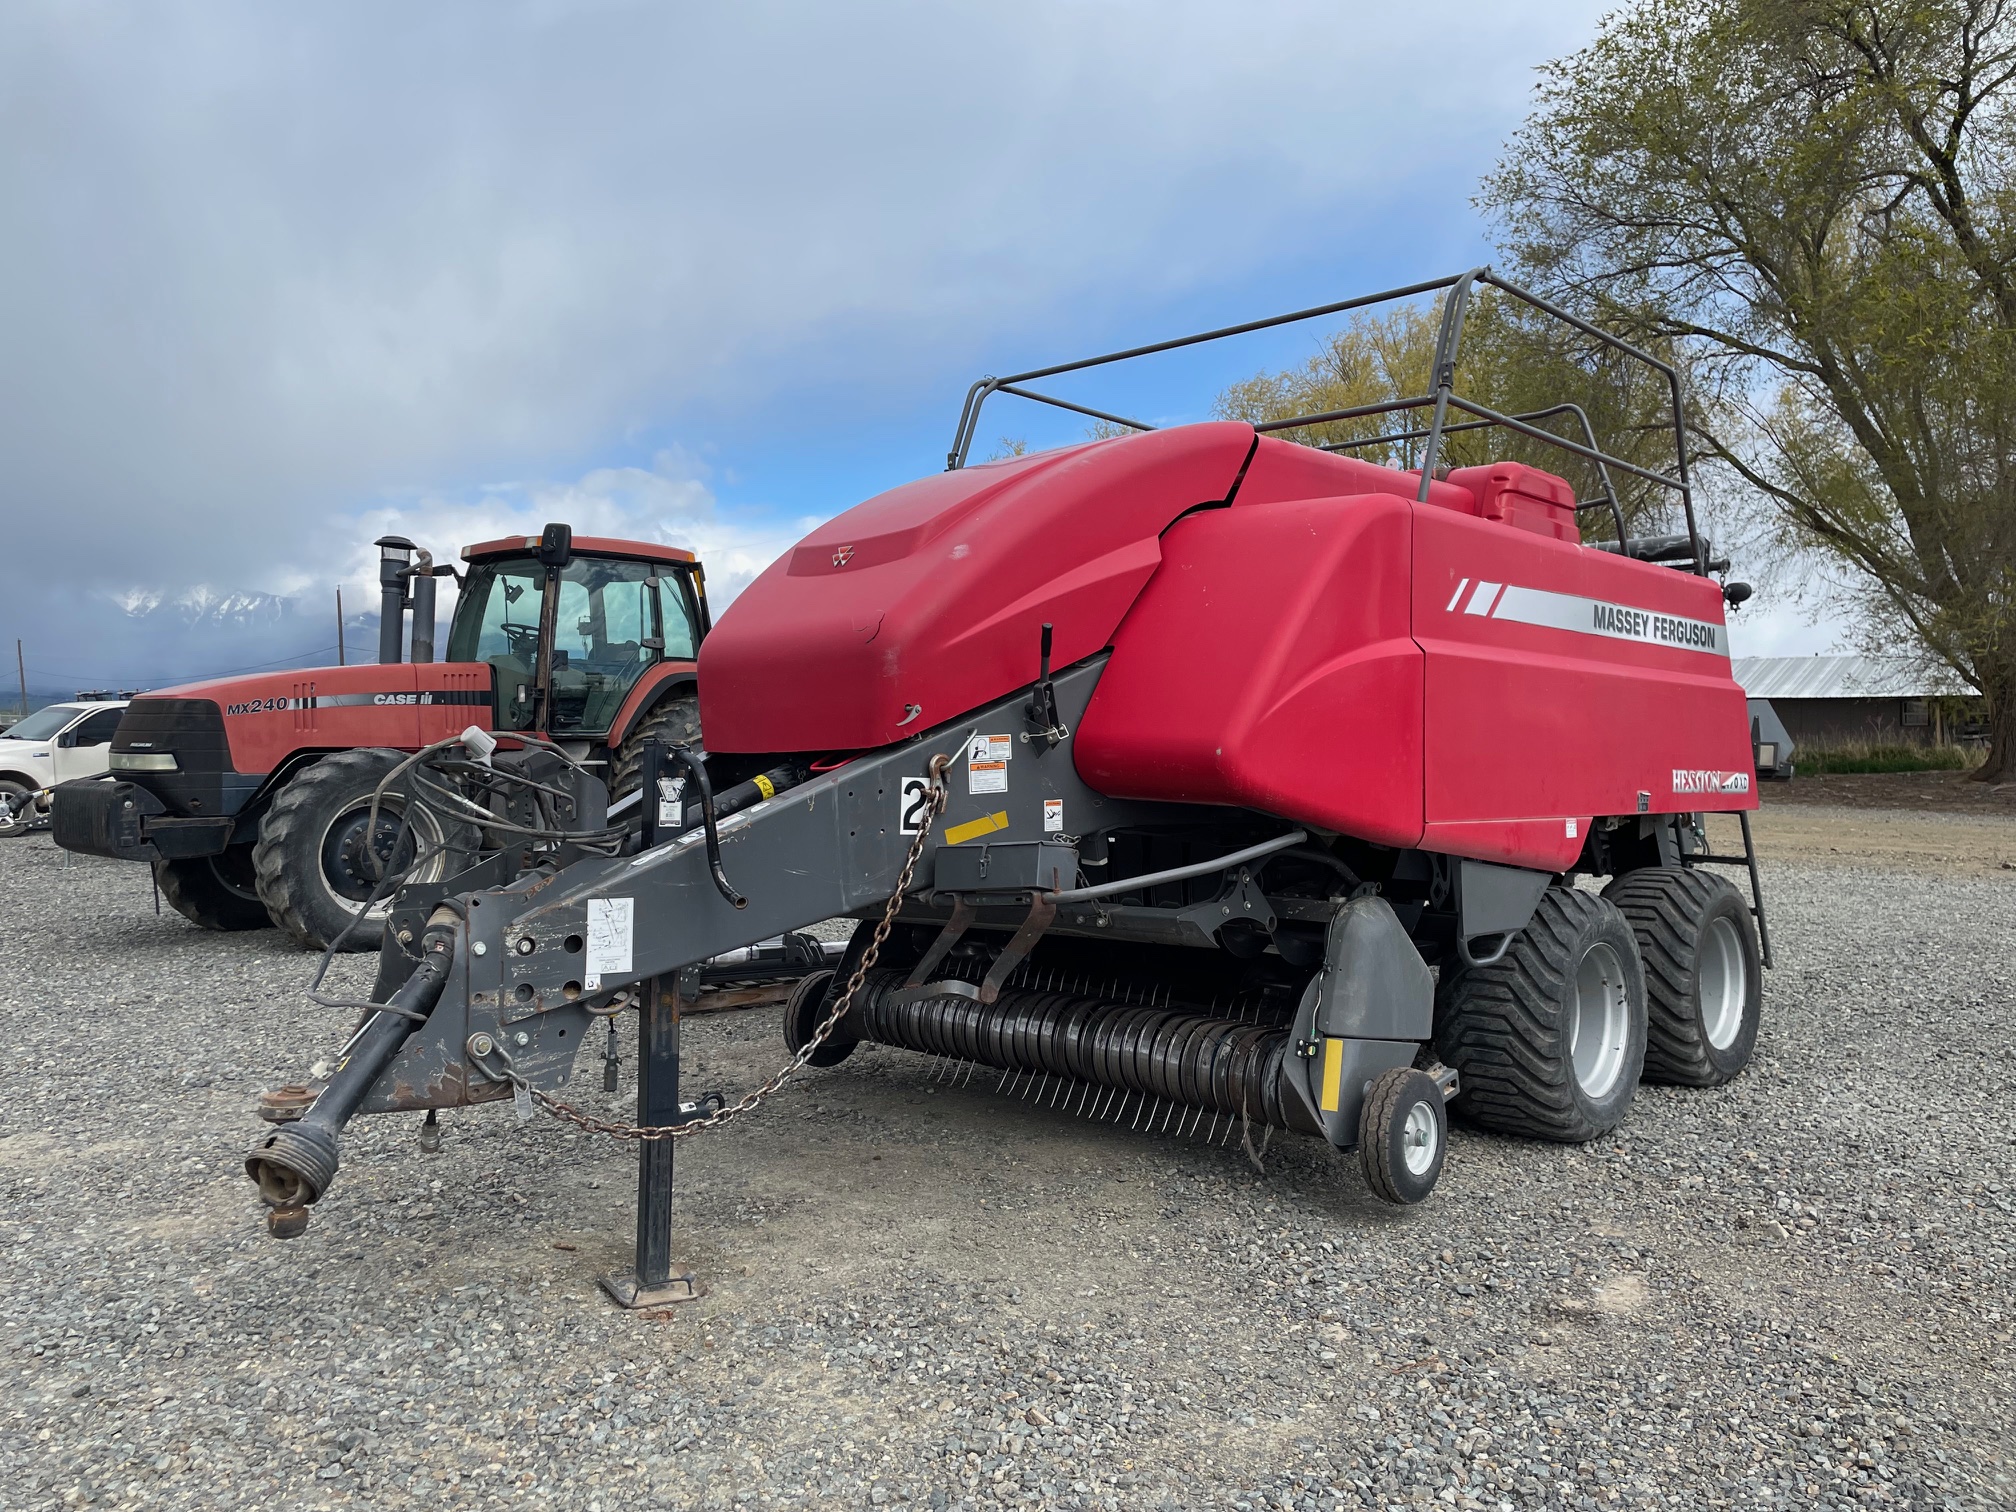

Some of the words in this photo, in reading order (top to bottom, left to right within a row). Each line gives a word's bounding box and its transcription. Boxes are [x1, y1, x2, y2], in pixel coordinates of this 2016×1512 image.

[1593, 604, 1649, 637] MASSEY
[1653, 616, 1715, 649] FERGUSON
[226, 697, 288, 716] MX240
[373, 694, 417, 705] CASE
[1672, 769, 1721, 794] HESSTON
[903, 780, 927, 831] 2
